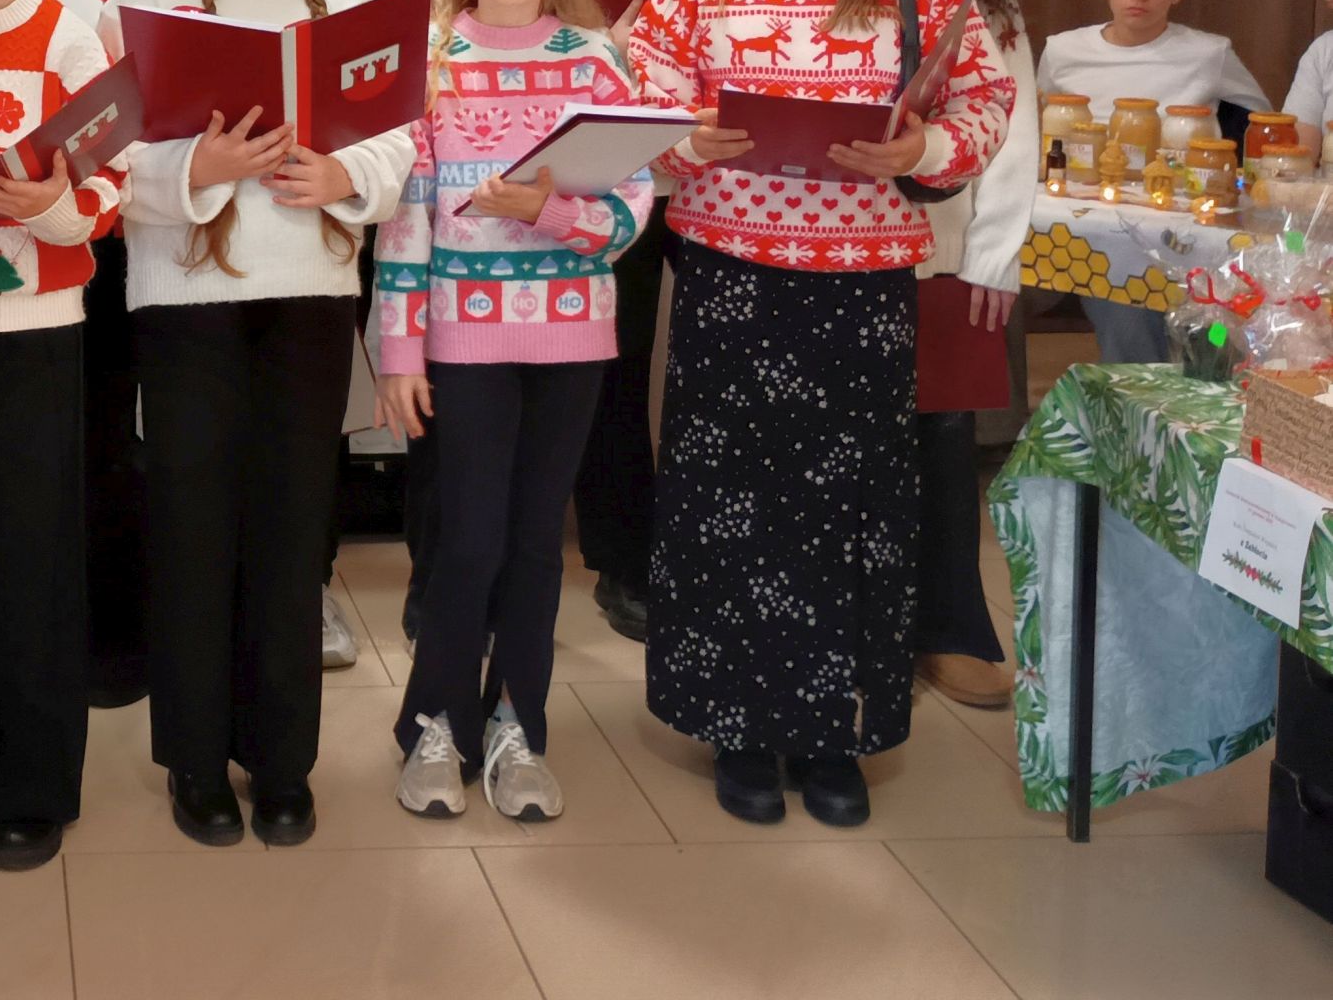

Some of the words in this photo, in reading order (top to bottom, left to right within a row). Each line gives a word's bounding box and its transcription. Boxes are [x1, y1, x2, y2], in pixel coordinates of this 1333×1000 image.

[467, 298, 490, 311] HO
[517, 296, 535, 310] HO
[558, 297, 582, 310] HO
